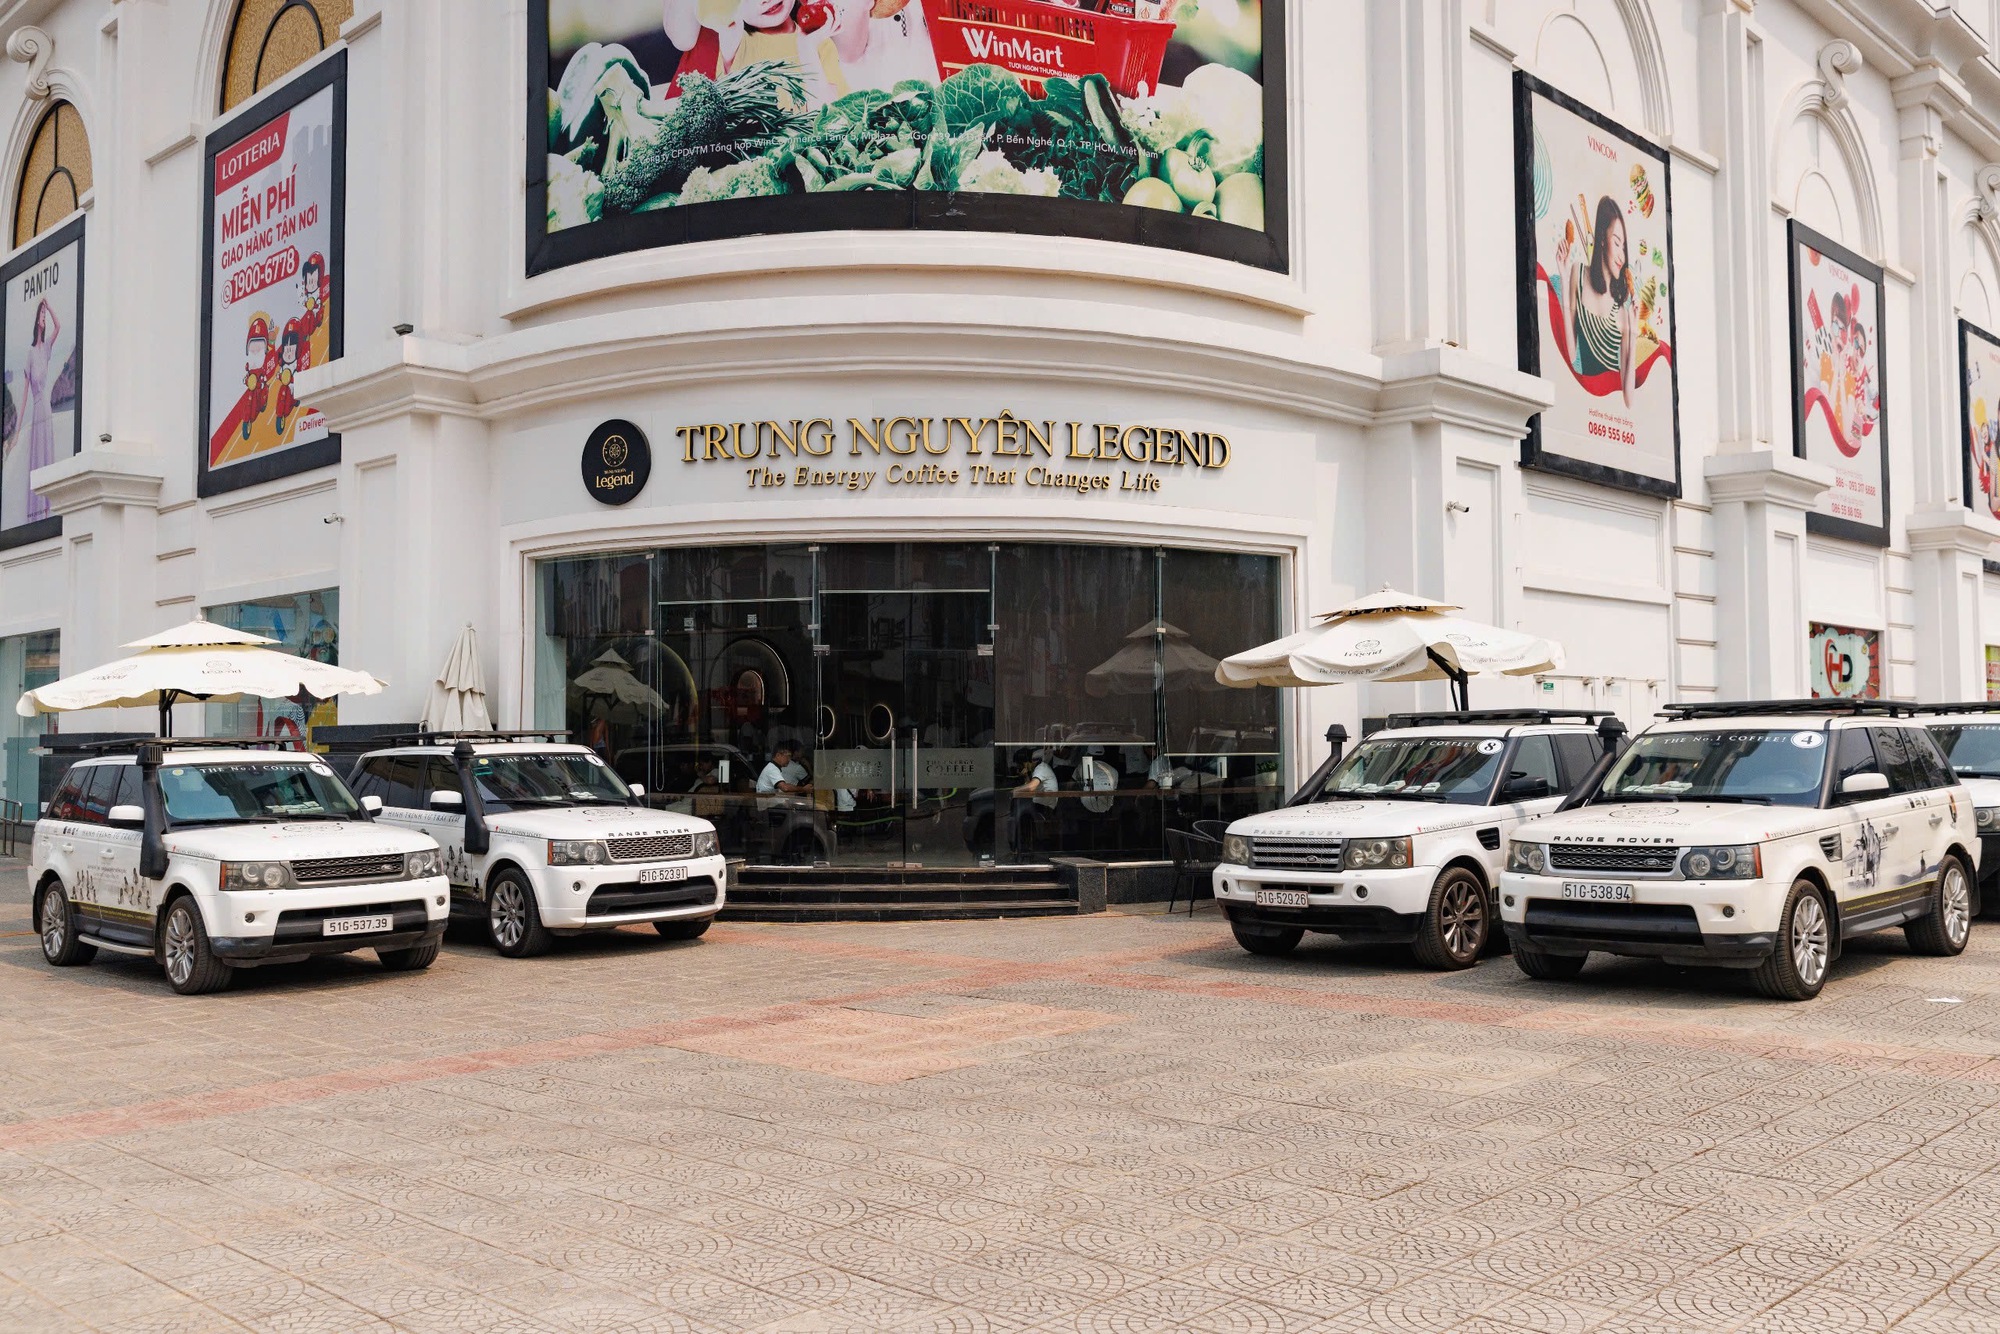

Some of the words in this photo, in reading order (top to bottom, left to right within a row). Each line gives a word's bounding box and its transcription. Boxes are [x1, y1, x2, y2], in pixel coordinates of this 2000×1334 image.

[962, 27, 1064, 68] WinMart
[222, 132, 280, 180] LOTTERIA
[671, 145, 708, 158] CPDVTM
[710, 142, 731, 154] Tổng
[734, 141, 752, 152] hợp
[997, 133, 1004, 142] P.
[1006, 134, 1024, 144] Bến
[1027, 135, 1055, 147] Nghé,
[1120, 145, 1137, 157] Việt
[1141, 148, 1159, 159] Nam
[1587, 135, 1617, 162] VINCOM
[222, 185, 262, 244] MIỄN
[266, 164, 297, 219] PHÍ
[222, 243, 243, 269] GIAO
[245, 227, 273, 258] HÀNG
[275, 215, 296, 244] TẬN
[299, 202, 318, 231] NƠI
[24, 262, 59, 302] PANTIO
[234, 248, 295, 300] 1900-6778
[676, 418, 836, 462] TRUNG
[847, 409, 1056, 458] NGUYÊN
[1065, 421, 1232, 470] LEGEND
[1589, 421, 1606, 437] 0869
[1608, 426, 1620, 441] 555
[1622, 431, 1635, 445] 660
[596, 471, 634, 489] Legend
[747, 466, 785, 488] The
[793, 465, 876, 490] Energy
[886, 463, 960, 485] Coffee
[970, 464, 1016, 485] That
[1026, 465, 1110, 494] Changes
[1120, 471, 1162, 492] Life
[1429, 740, 1475, 748] COFFEE!
[1484, 742, 1496, 751] 8
[1801, 735, 1813, 745] 4
[642, 868, 685, 882] 51G-523.91
[1257, 891, 1307, 906] 51G-529.26
[1565, 884, 1630, 900] 51G-538.94
[329, 919, 387, 932] 51G-537.39
